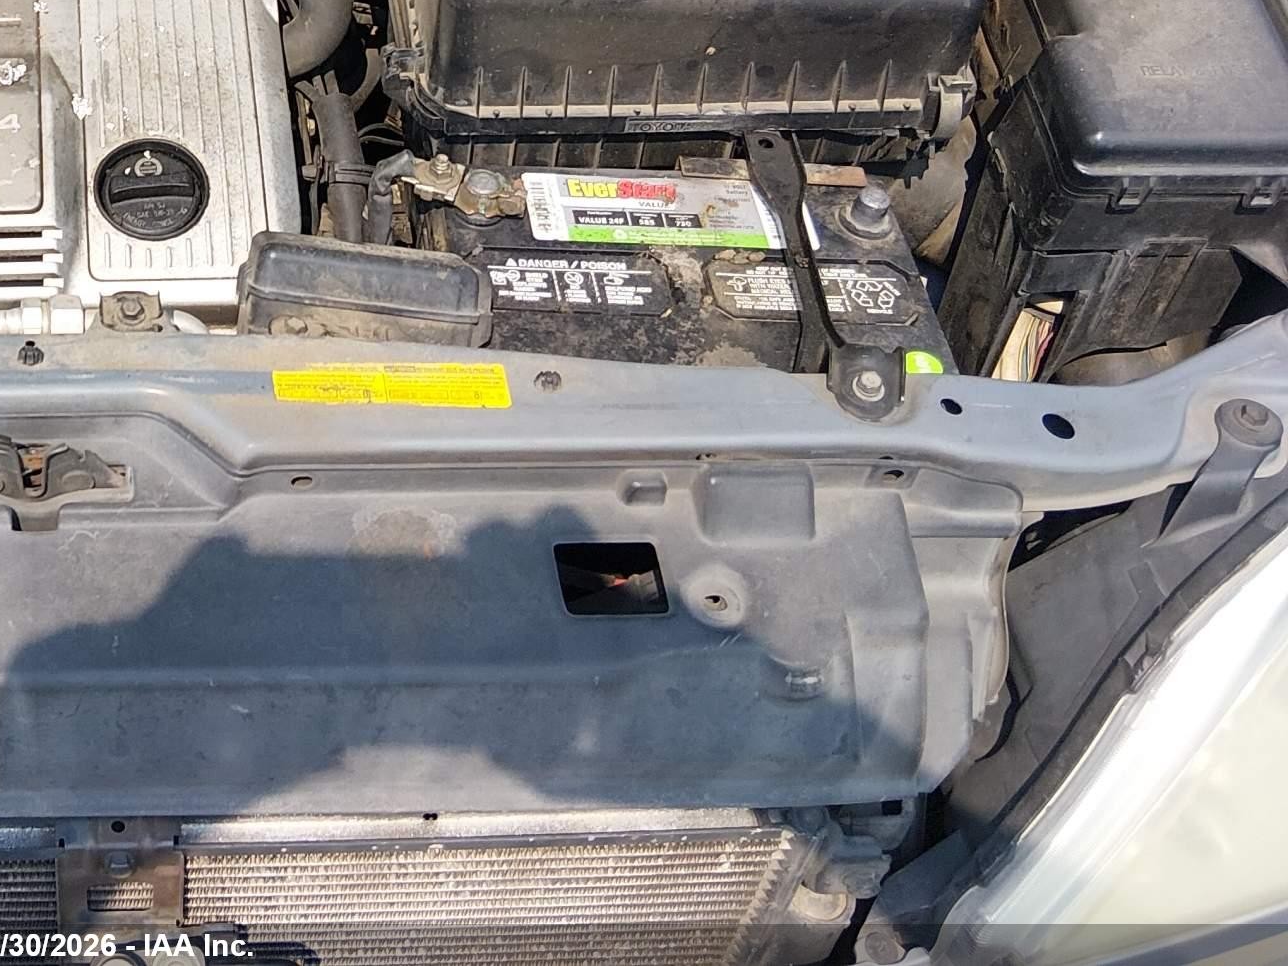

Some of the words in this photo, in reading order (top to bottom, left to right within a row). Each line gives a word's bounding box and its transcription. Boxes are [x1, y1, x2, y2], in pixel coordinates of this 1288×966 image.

[578, 216, 608, 224] VALUE
[519, 259, 568, 269] DANGER
[580, 261, 627, 271] POISON
